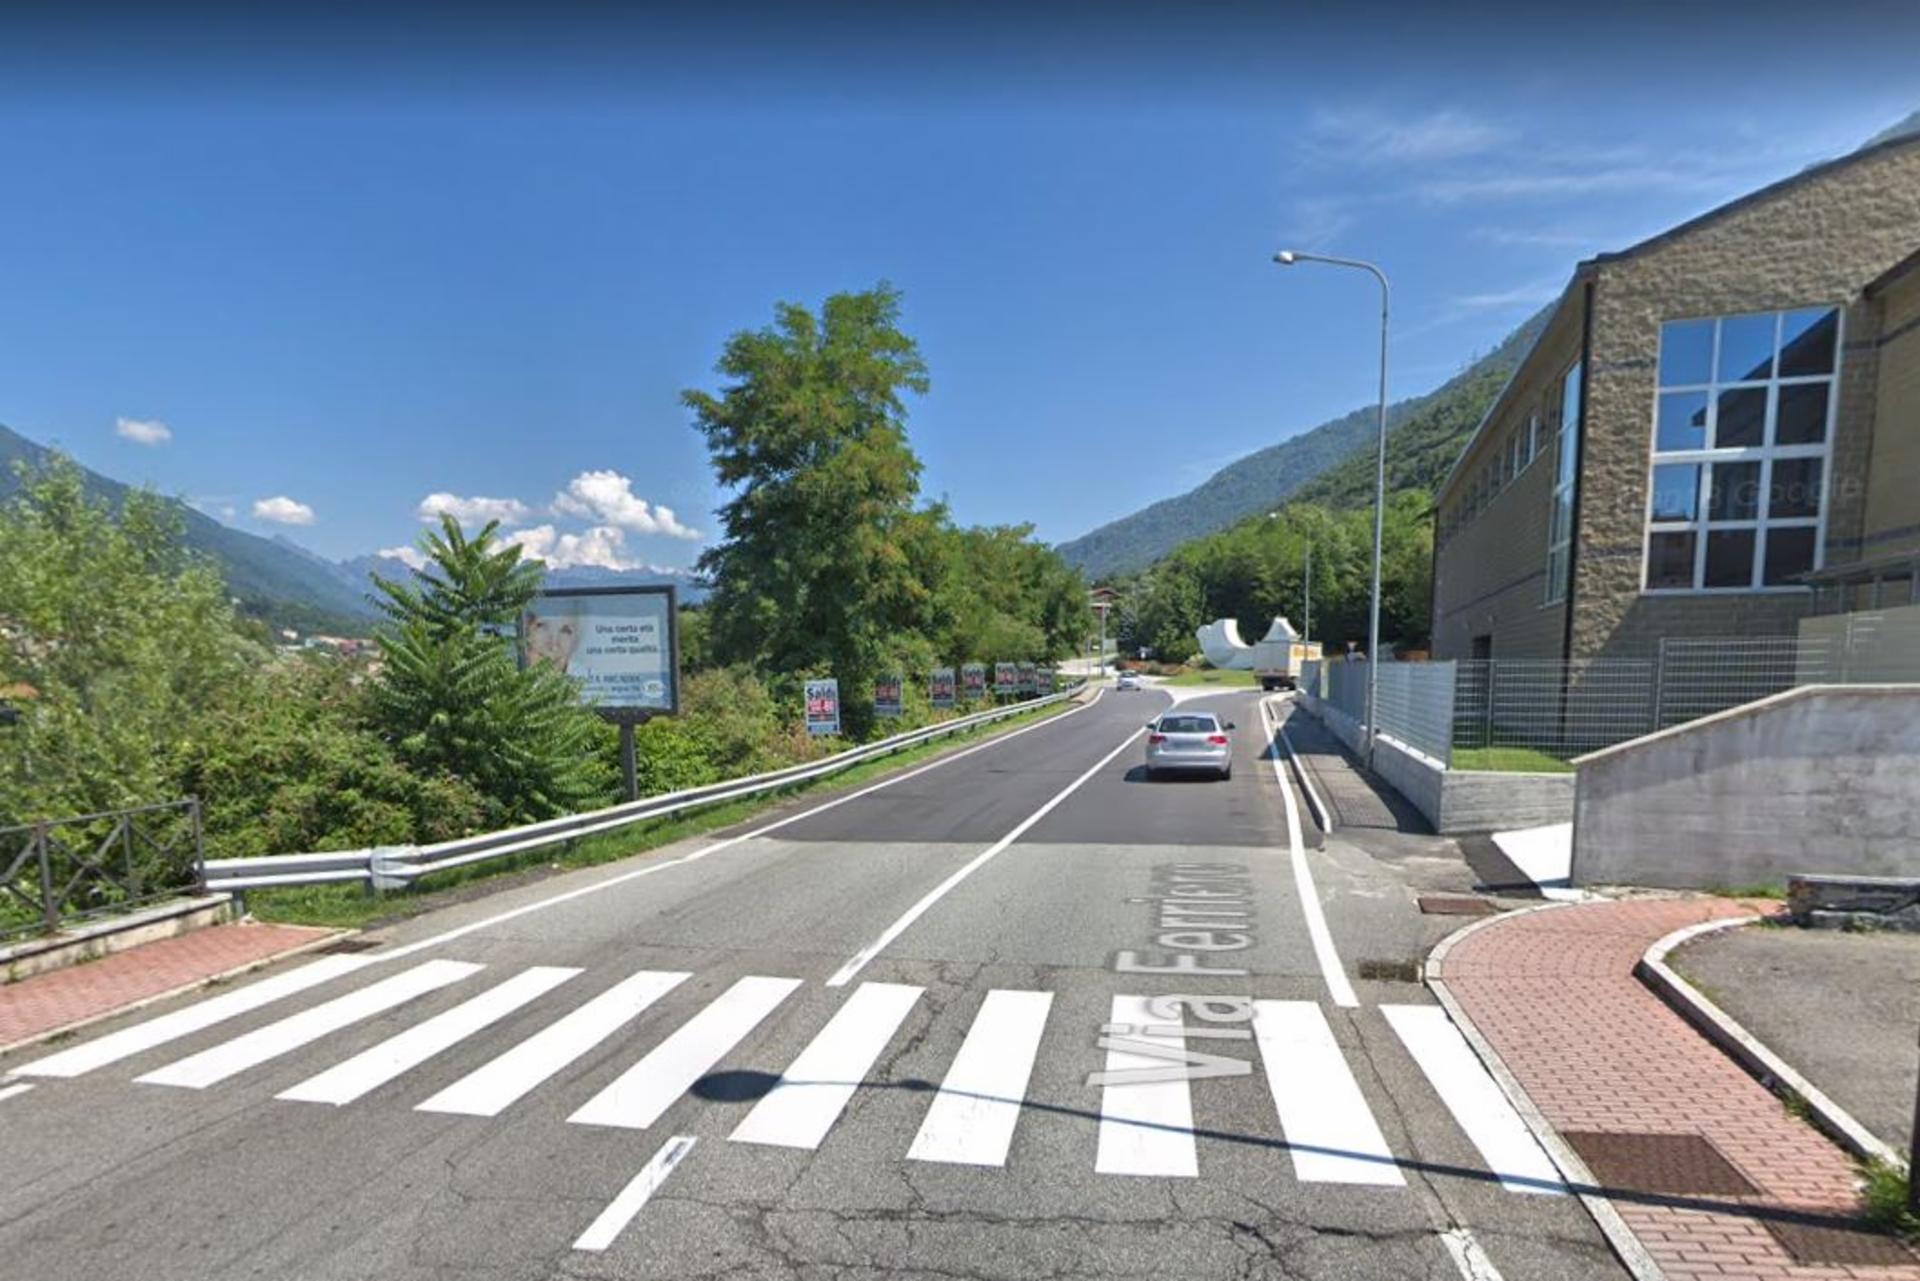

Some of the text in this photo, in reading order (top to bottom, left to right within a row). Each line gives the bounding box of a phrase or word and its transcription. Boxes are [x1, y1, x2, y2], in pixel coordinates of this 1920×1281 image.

[595, 624, 613, 634] Una
[615, 624, 638, 633] certa
[611, 634, 639, 644] merita
[604, 646, 627, 654] certa
